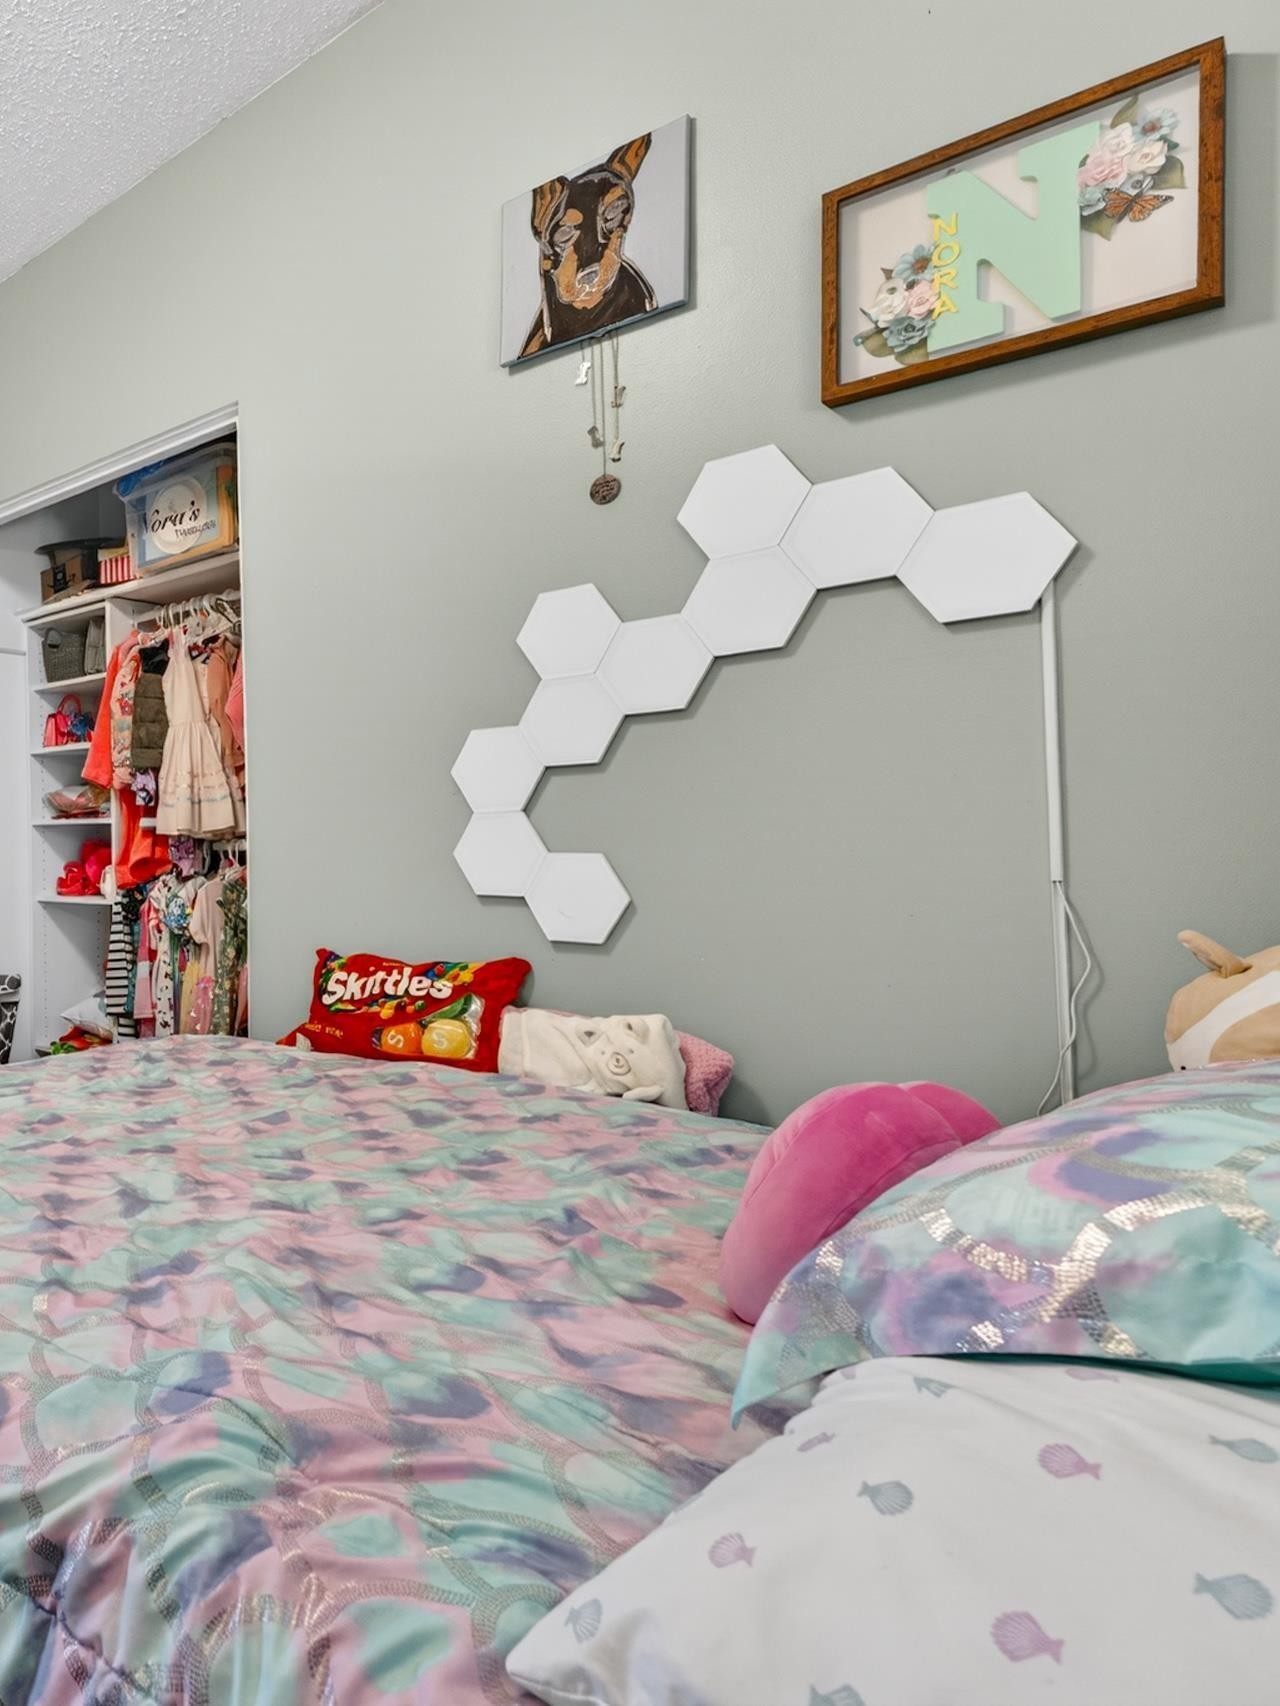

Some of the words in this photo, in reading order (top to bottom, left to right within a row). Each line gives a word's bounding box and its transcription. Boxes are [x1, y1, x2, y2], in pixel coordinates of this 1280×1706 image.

[926, 120, 1101, 353] N
[930, 212, 962, 321] NORA
[321, 966, 454, 1006] Skittles
